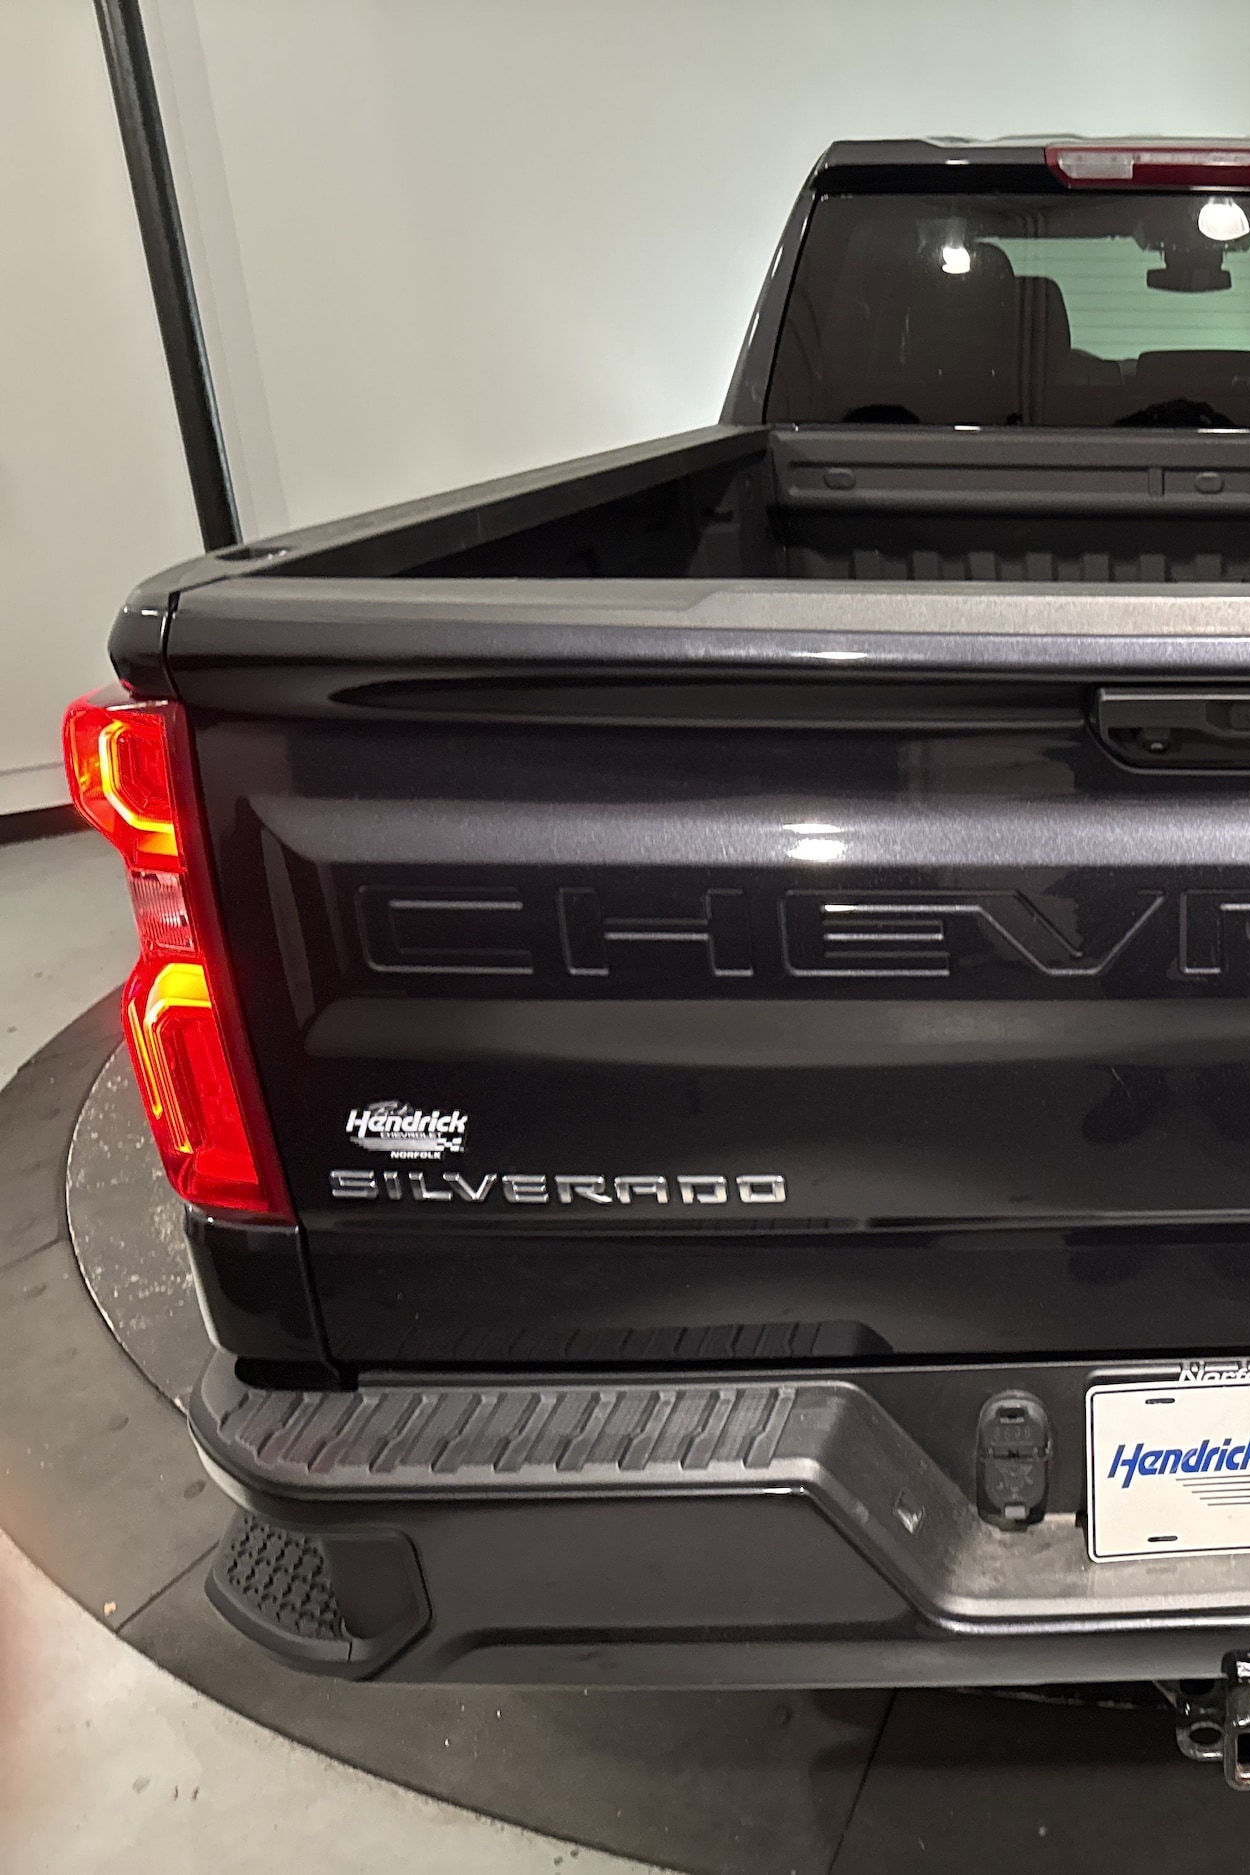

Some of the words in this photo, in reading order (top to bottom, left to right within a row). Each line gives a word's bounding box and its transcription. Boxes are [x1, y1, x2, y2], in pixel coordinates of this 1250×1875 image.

[345, 1108, 469, 1138] Hendrick
[390, 1150, 442, 1160] NORFOLK
[330, 1170, 787, 1204] SILVERADO
